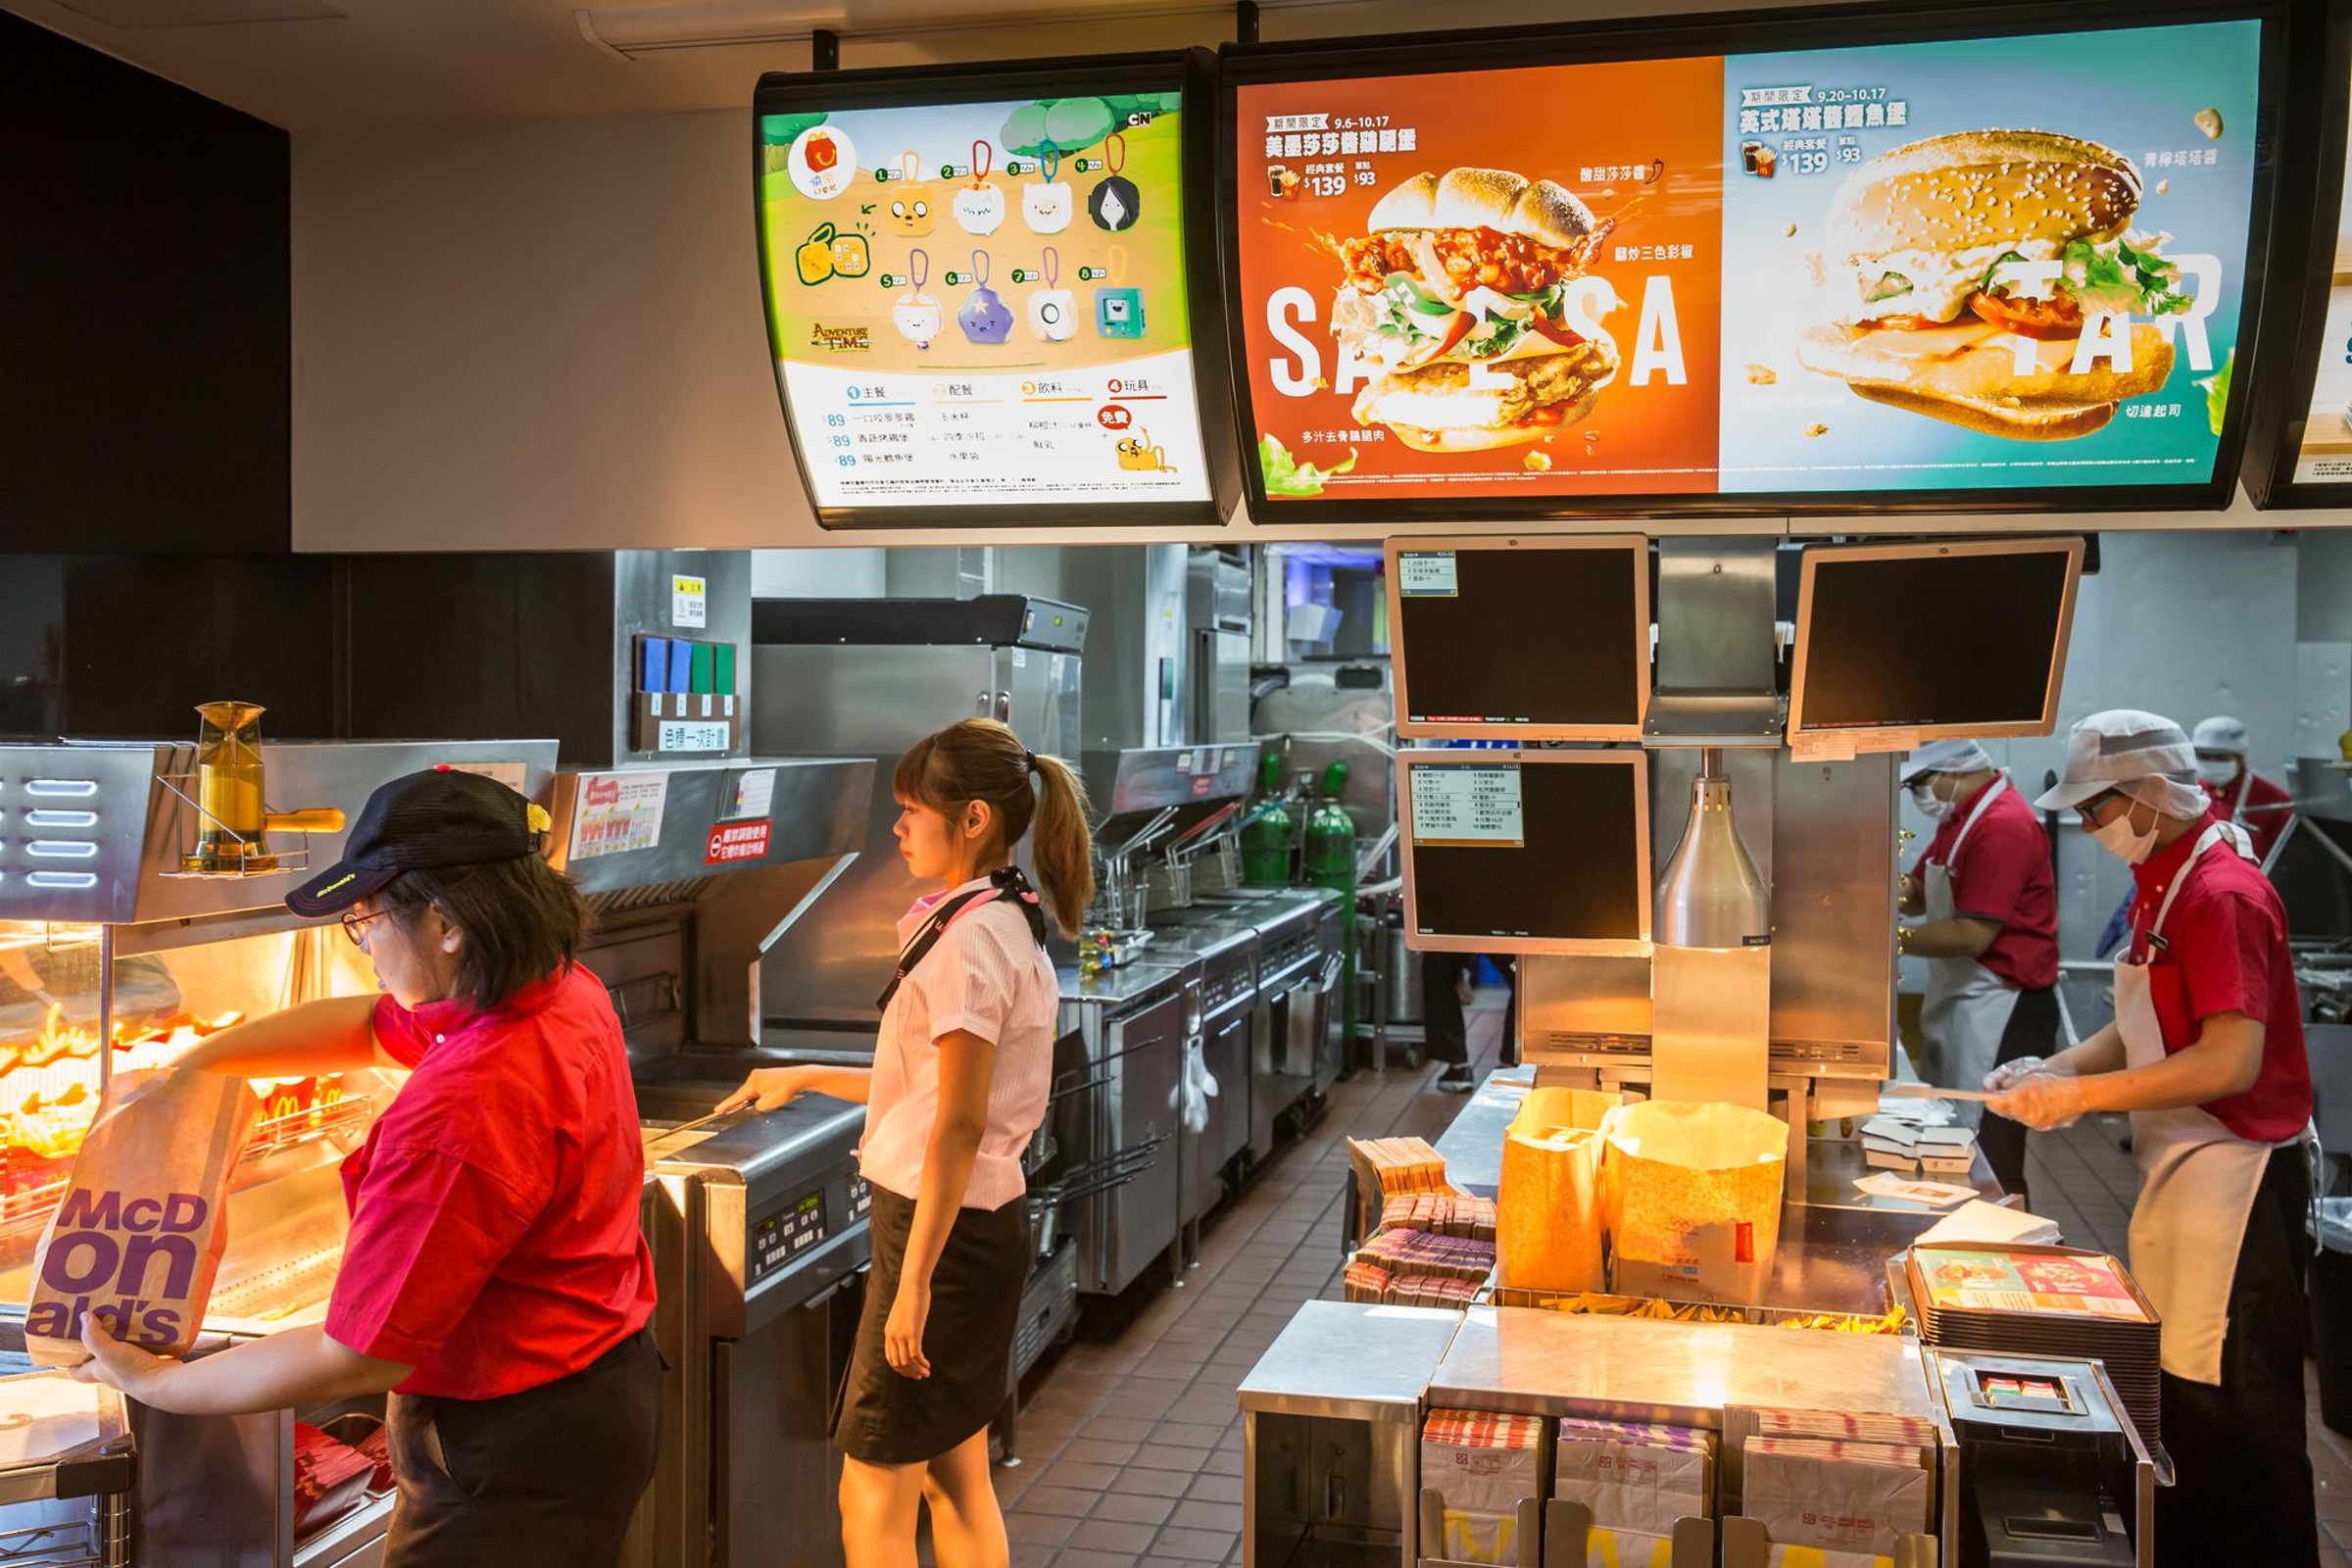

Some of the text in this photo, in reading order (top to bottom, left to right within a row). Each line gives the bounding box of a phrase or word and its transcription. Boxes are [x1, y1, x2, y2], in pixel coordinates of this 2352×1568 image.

[1750, 89, 1804, 102] 期間限定
[1128, 113, 1152, 125] CN
[1274, 117, 1322, 130] 期間限定
[1837, 148, 1860, 163] $93
[1782, 152, 1829, 174] $139
[1303, 176, 1347, 196] $139
[1353, 172, 1376, 186] $93
[1124, 379, 1150, 391] 玩具
[2126, 404, 2181, 418] 切達起司
[56, 1188, 208, 1233] McD
[41, 1230, 197, 1300] on
